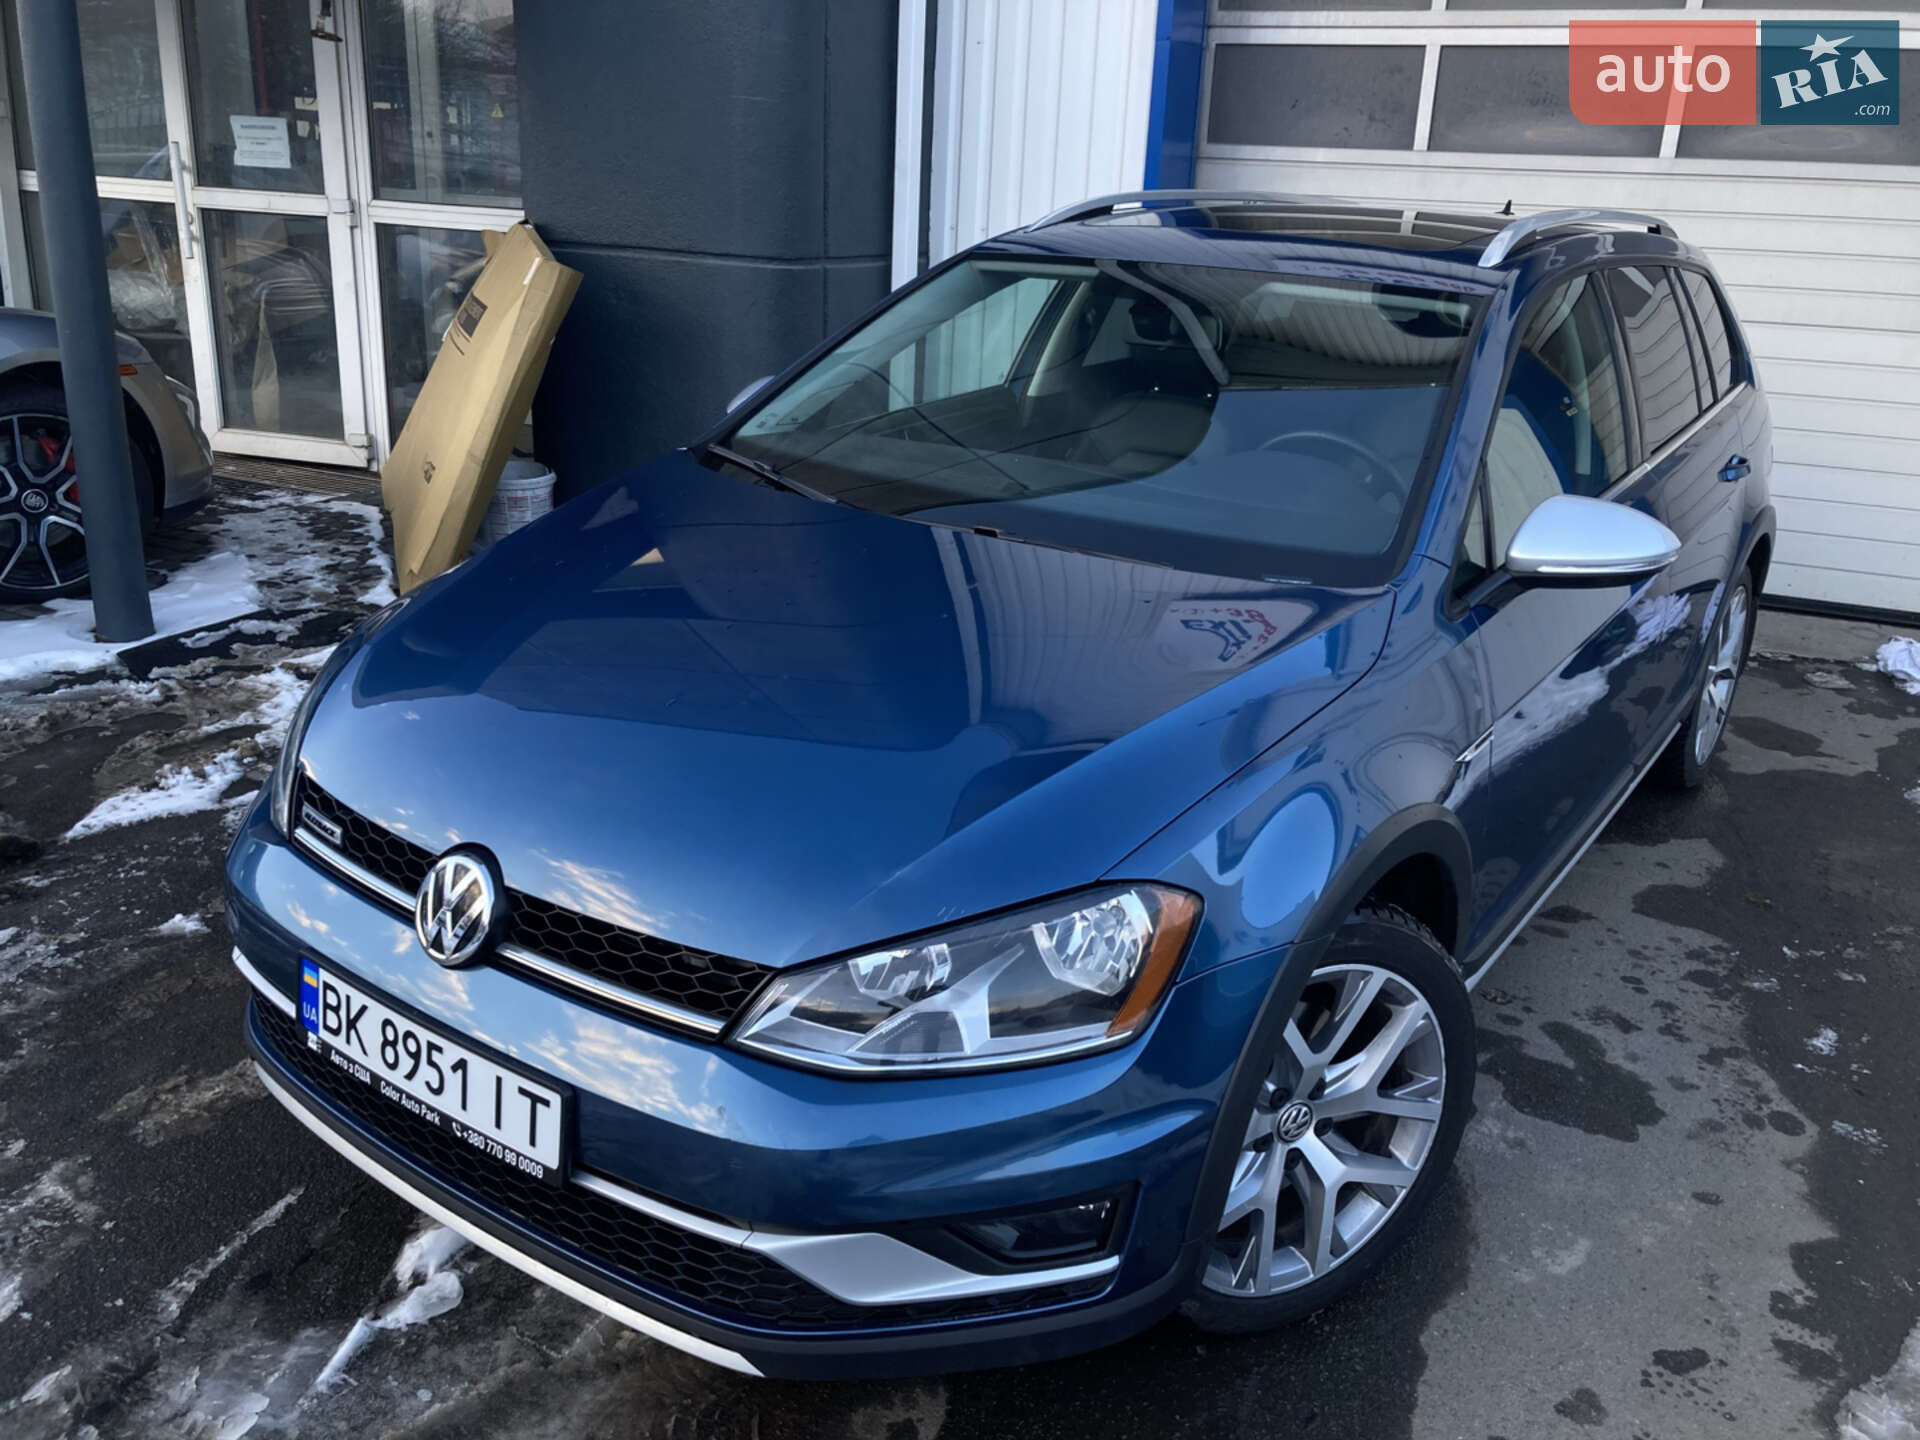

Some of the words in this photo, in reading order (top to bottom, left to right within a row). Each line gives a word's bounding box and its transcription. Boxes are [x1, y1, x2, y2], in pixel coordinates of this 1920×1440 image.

[303, 1003, 318, 1025] UA
[322, 980, 368, 1057] BK
[381, 1017, 469, 1112] 8951
[494, 1075, 551, 1148] IT
[354, 1064, 371, 1085] США
[380, 1080, 400, 1102] Color
[400, 1093, 421, 1115] Auto
[420, 1104, 440, 1126] Park
[486, 1139, 503, 1159] 770
[504, 1149, 517, 1166] 99
[518, 1156, 544, 1179] 0009
